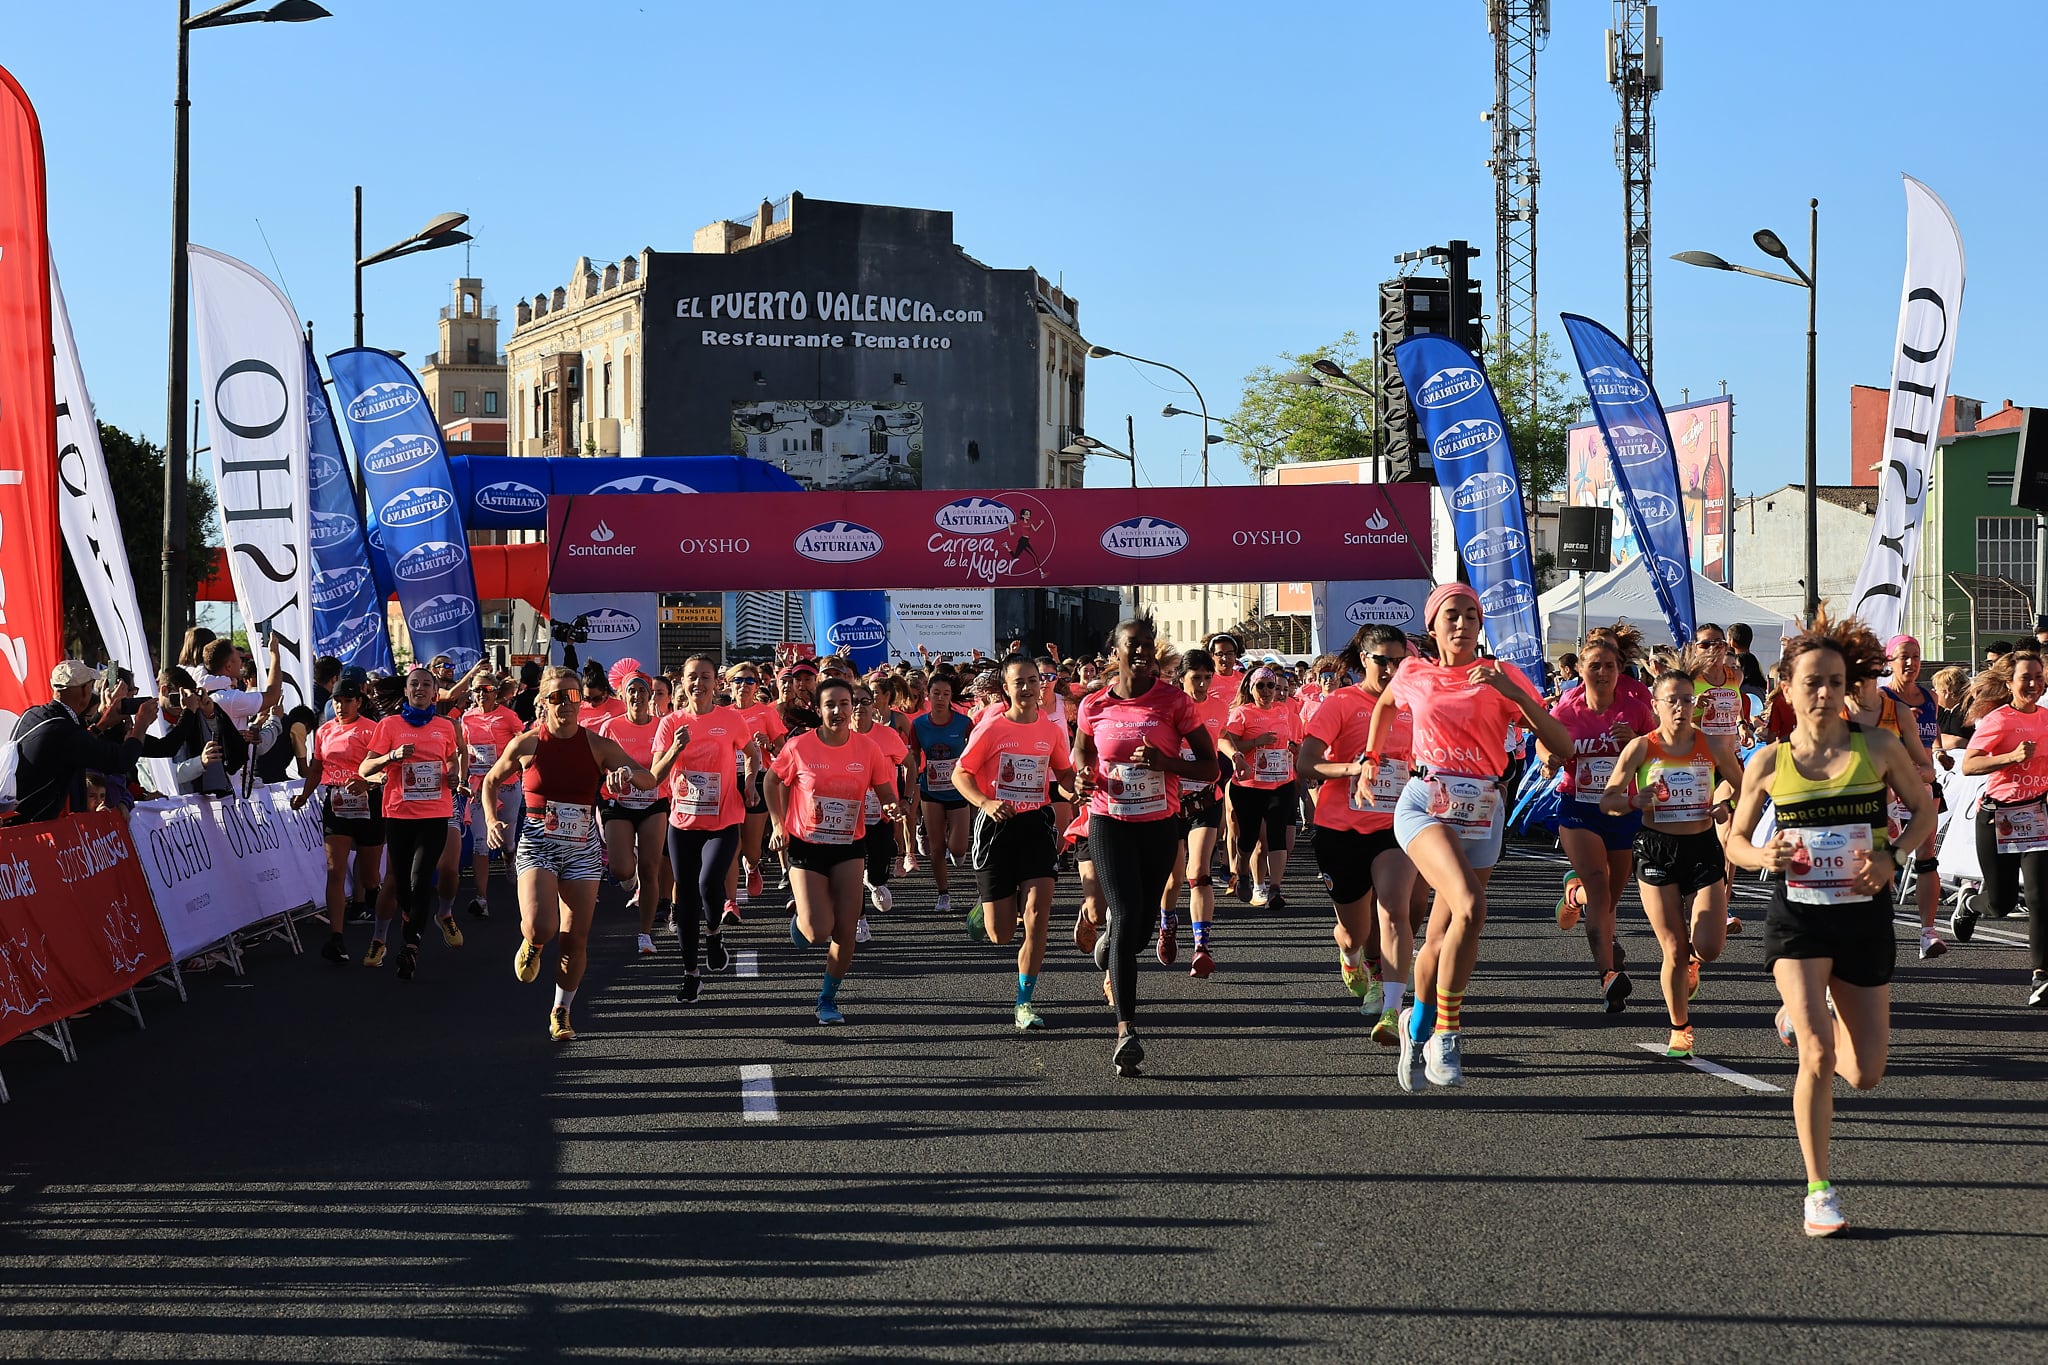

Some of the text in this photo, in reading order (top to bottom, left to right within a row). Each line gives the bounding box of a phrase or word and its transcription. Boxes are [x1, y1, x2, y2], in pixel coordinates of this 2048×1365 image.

[676, 290, 983, 322] EL PUERTO VALENCIA.com
[702, 330, 951, 349] Restaurante Tematico
[481, 492, 540, 507] ASTURIANA
[940, 511, 1009, 526] ASTURIANA
[801, 536, 876, 552] ASTURIANA
[927, 532, 995, 553] Carrera
[1107, 532, 1182, 548] ASTURIANA
[1232, 529, 1301, 546] OYSHO
[568, 543, 636, 556] Santander
[680, 538, 750, 554] OYSHO
[943, 549, 1020, 583] de la Mujer
[1288, 583, 1306, 594] PVC
[1350, 607, 1410, 620] ASTURIANA
[582, 624, 636, 634] STURIANA
[831, 629, 883, 642] ASTURIANA
[1124, 720, 1159, 728] Santander
[1016, 773, 1033, 781] 016
[690, 788, 705, 797] 016
[1125, 783, 1146, 792] 016
[1672, 788, 1693, 797] 016
[1451, 802, 1476, 812] 016
[560, 822, 578, 830] 016
[824, 815, 843, 825] 016
[149, 812, 212, 889] OYSHO
[1813, 856, 1845, 868] 016
